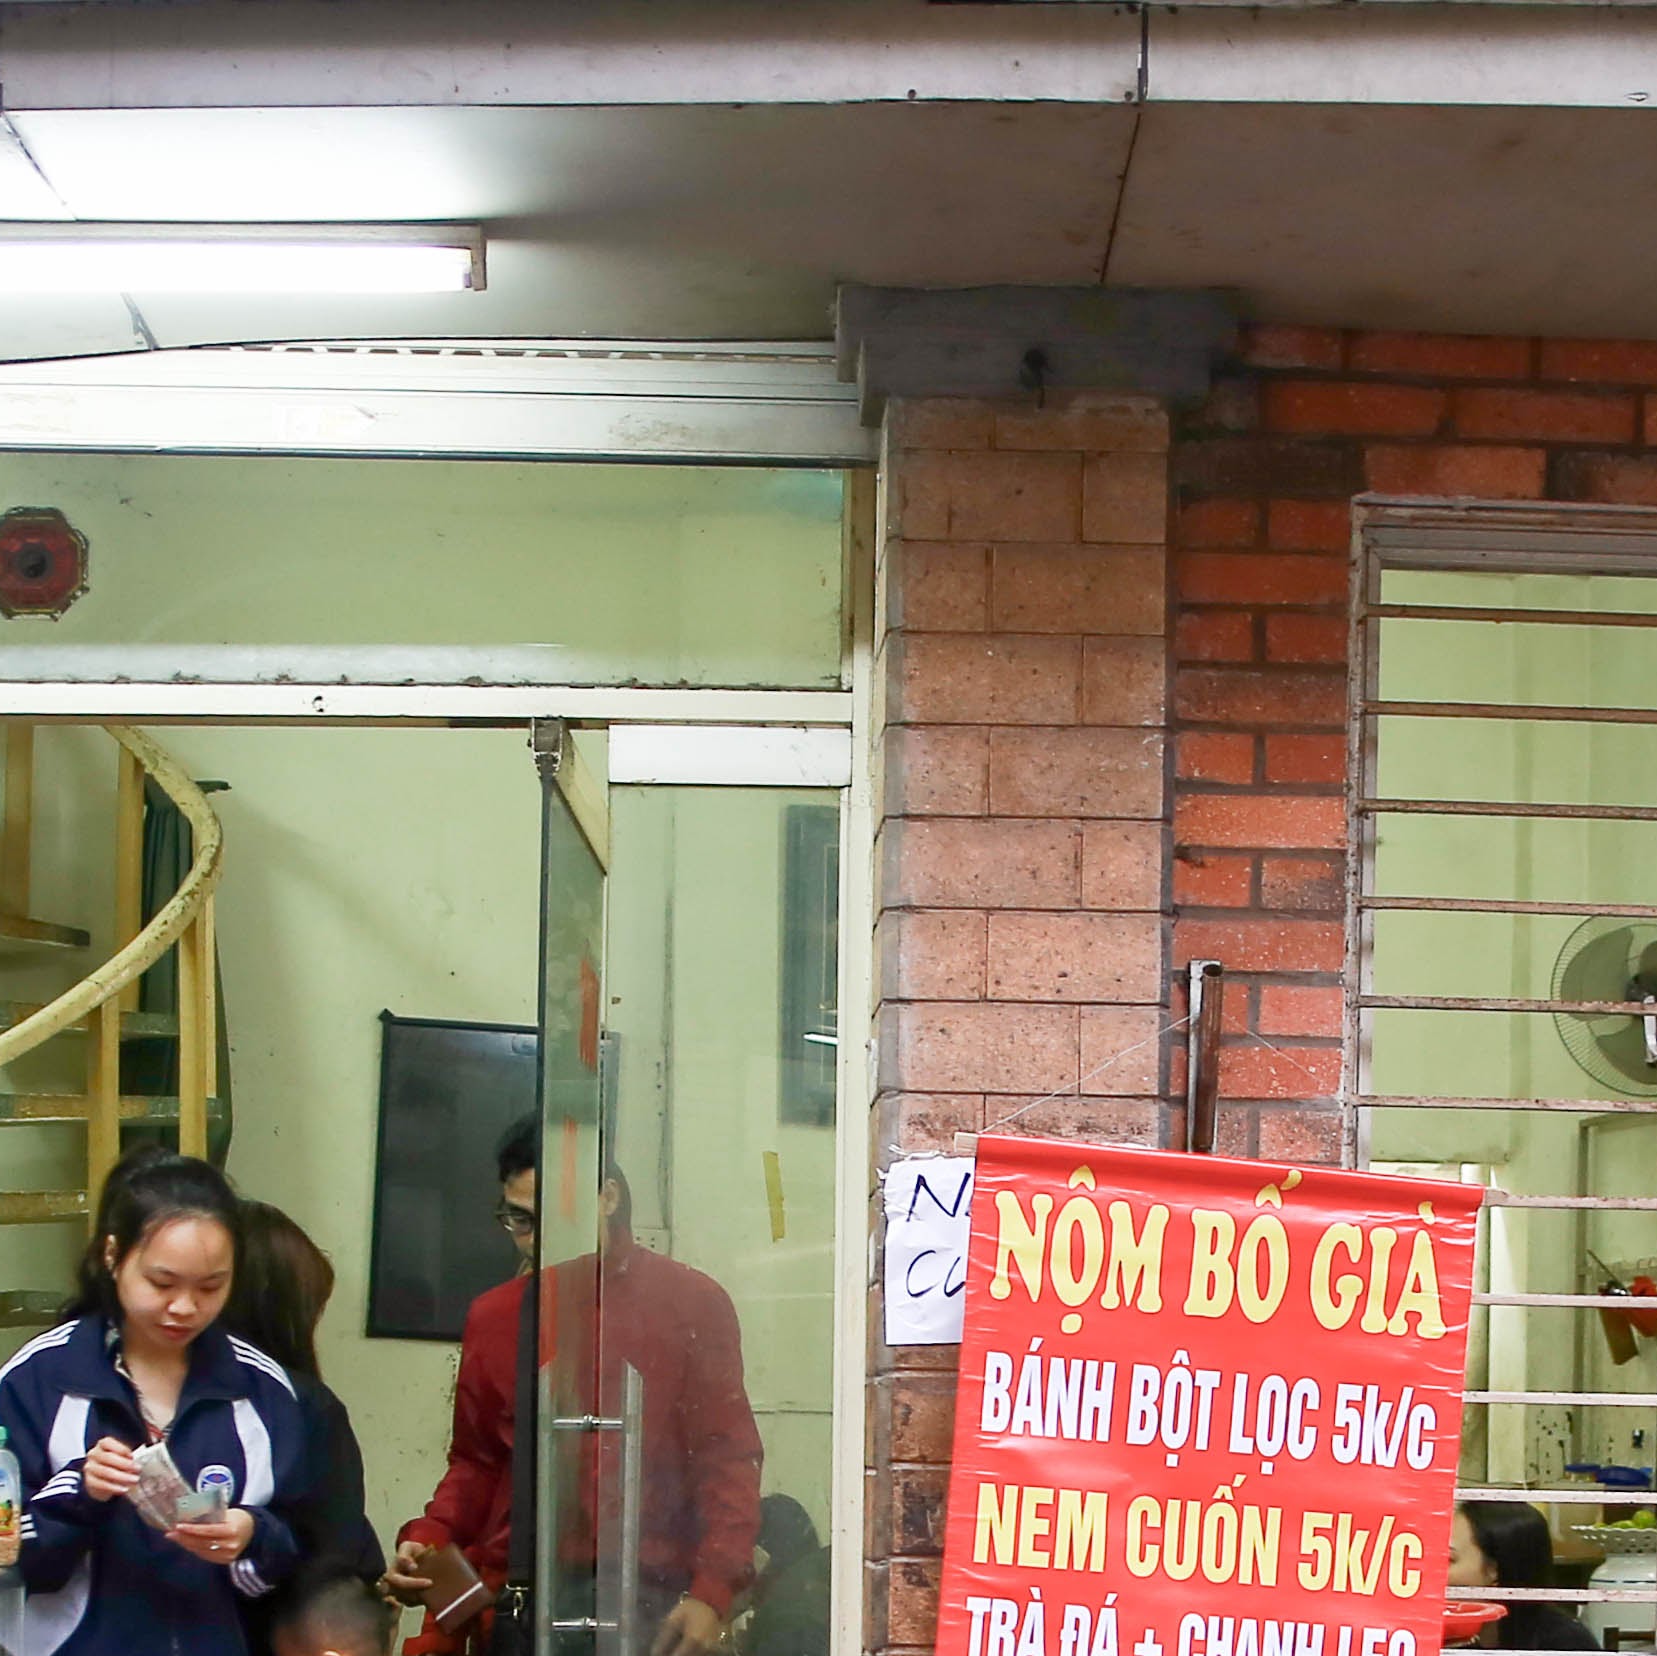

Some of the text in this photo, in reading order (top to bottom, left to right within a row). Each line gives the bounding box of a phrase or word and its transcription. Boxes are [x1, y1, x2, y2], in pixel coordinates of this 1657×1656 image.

[989, 1165, 1448, 1340] NỘM BỐ GIÀ
[980, 1336, 1117, 1444] BÁNH
[1125, 1348, 1221, 1468] BỘT
[1228, 1372, 1321, 1475] LỌC
[972, 1481, 1108, 1574] NEM
[1124, 1473, 1283, 1588] CUỐN
